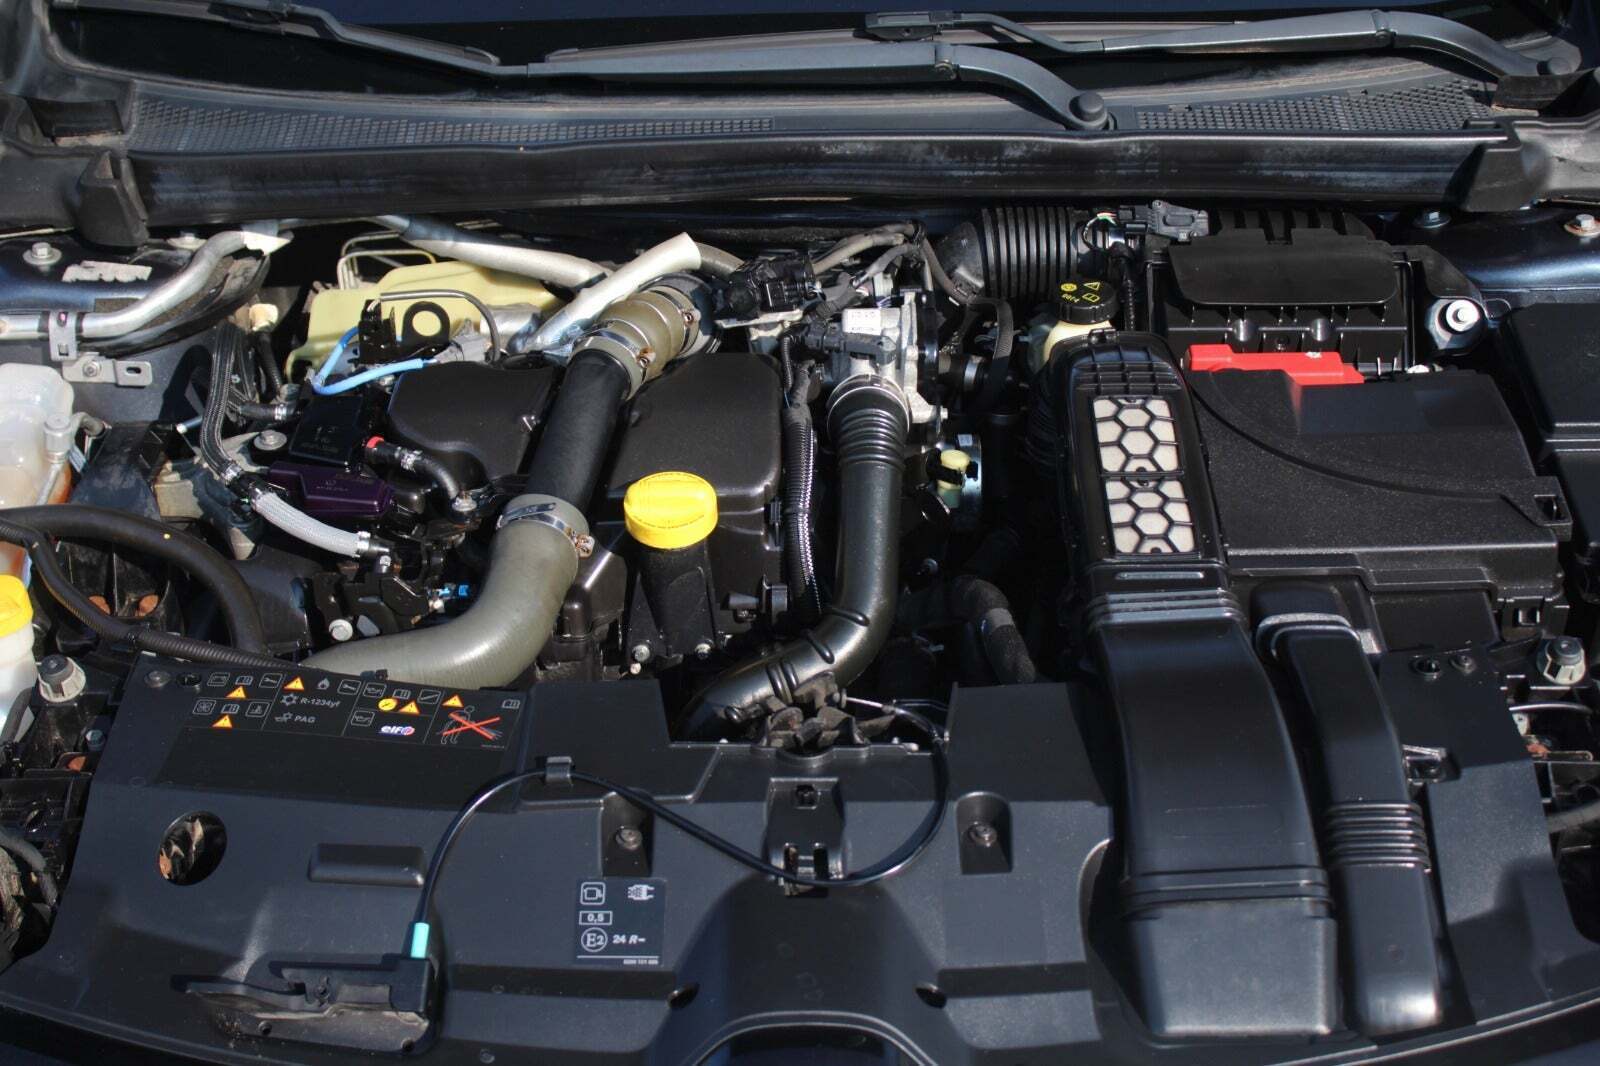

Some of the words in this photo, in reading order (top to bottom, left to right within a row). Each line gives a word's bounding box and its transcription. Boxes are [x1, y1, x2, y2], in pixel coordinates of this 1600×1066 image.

[300, 697, 341, 709] R-1234yf
[294, 715, 316, 723] PAG
[586, 933, 604, 947] E2
[612, 934, 626, 944] 24
